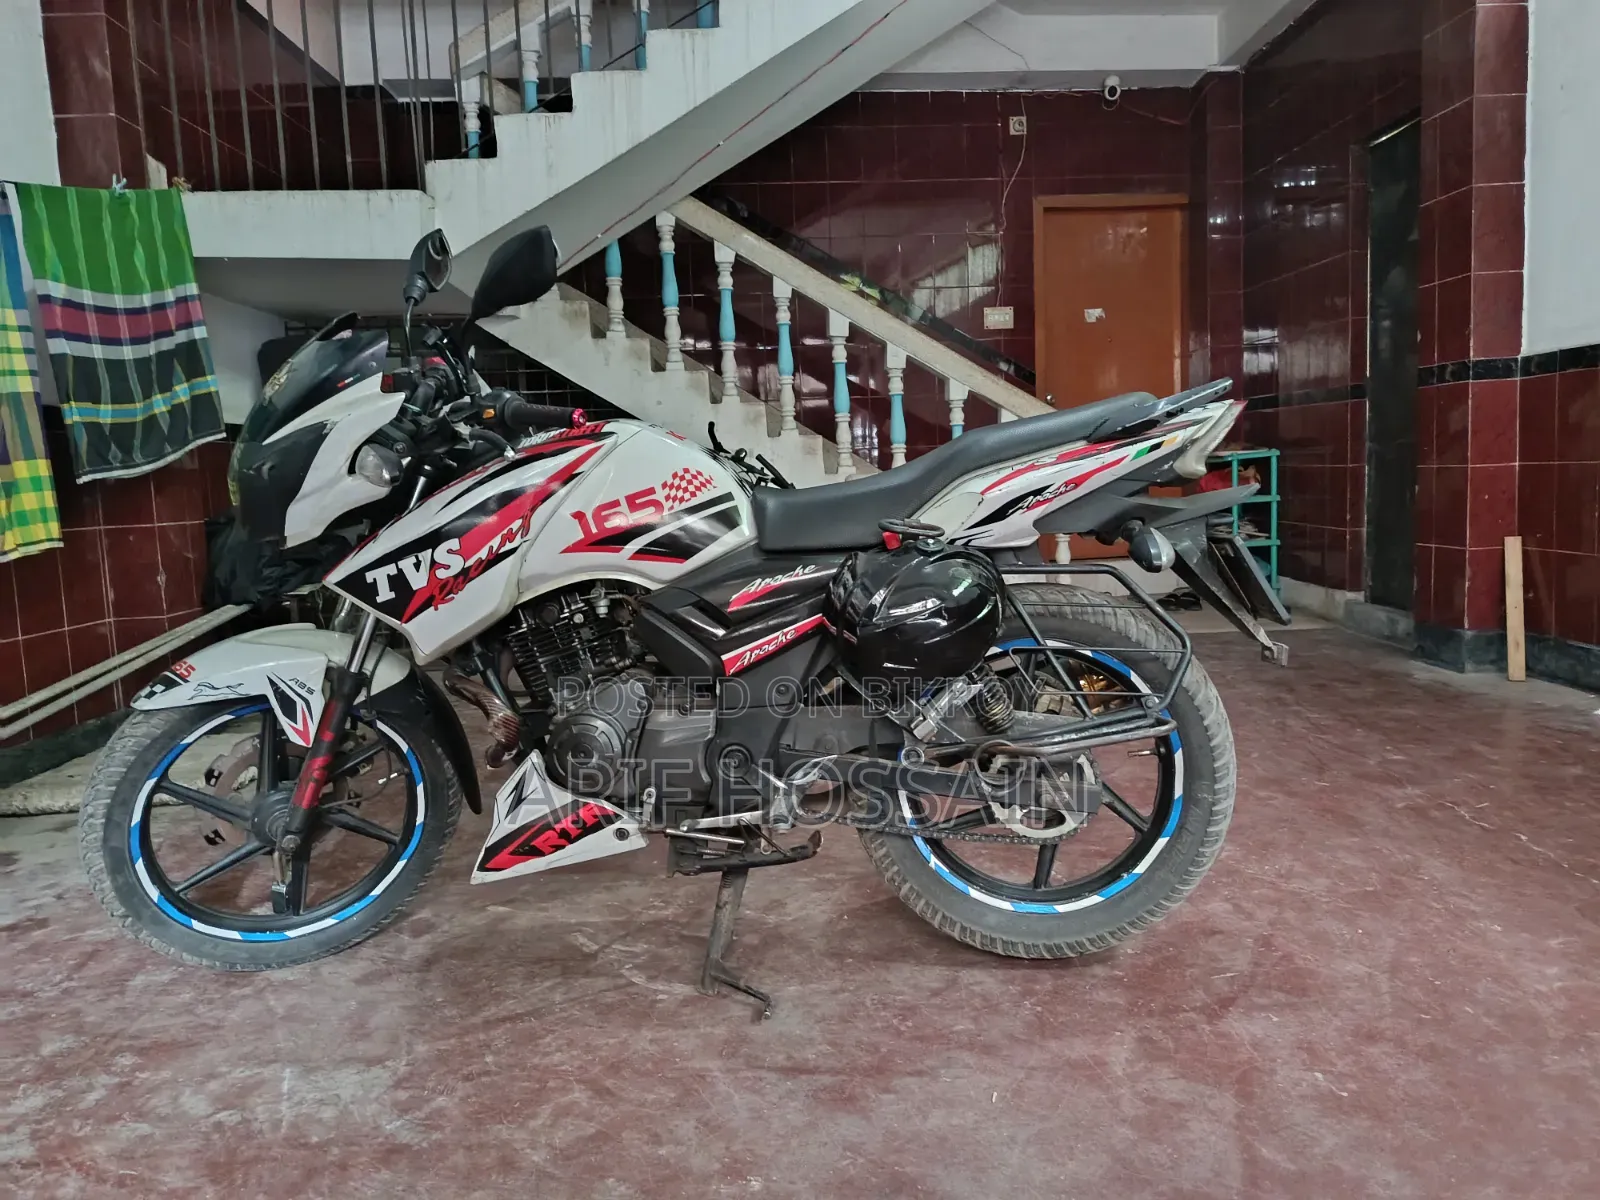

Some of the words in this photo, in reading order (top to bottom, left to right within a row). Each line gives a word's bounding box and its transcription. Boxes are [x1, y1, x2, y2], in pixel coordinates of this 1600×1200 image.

[569, 486, 665, 540] 165
[1005, 482, 1077, 516] Apache
[365, 537, 466, 604] TVS
[431, 501, 541, 612] Racing
[729, 564, 816, 602] Apache
[729, 629, 797, 676] Apache
[288, 677, 316, 696] ABS
